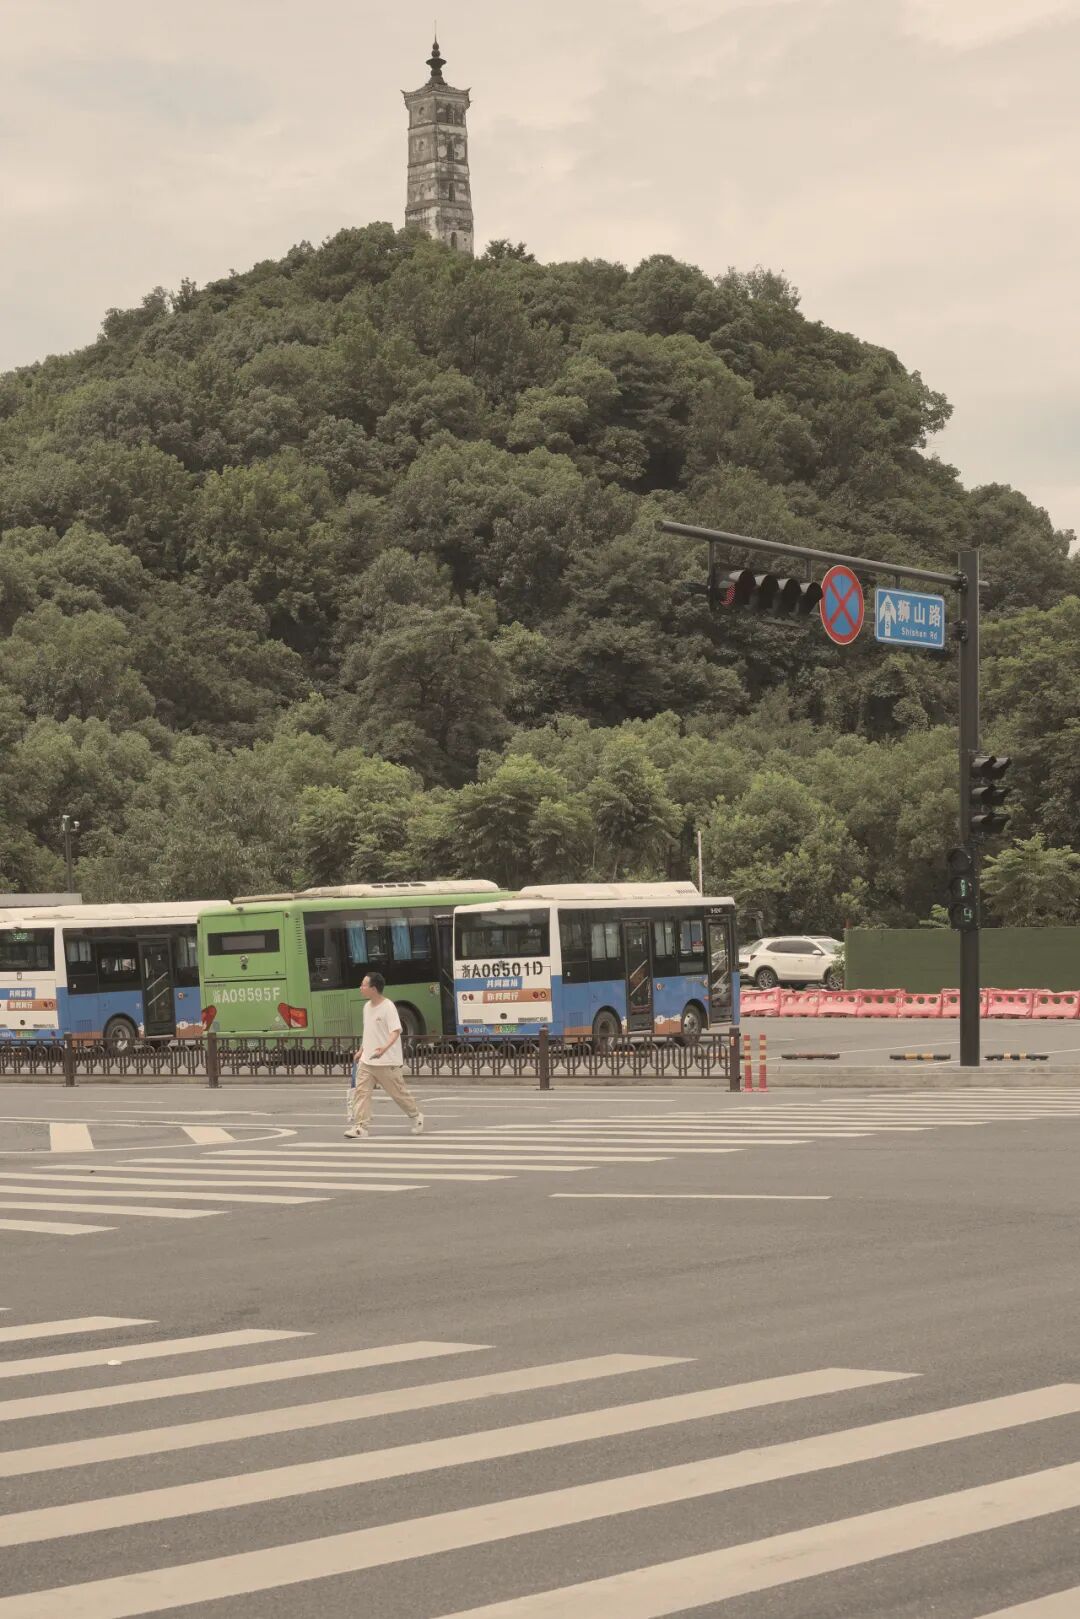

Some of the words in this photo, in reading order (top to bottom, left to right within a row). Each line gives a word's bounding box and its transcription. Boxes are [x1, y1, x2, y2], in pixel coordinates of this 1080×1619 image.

[902, 627, 926, 637] Shishan
[930, 632, 938, 640] Rd
[462, 961, 543, 978] 浙A06501D
[213, 987, 280, 1004] 浙A09595F
